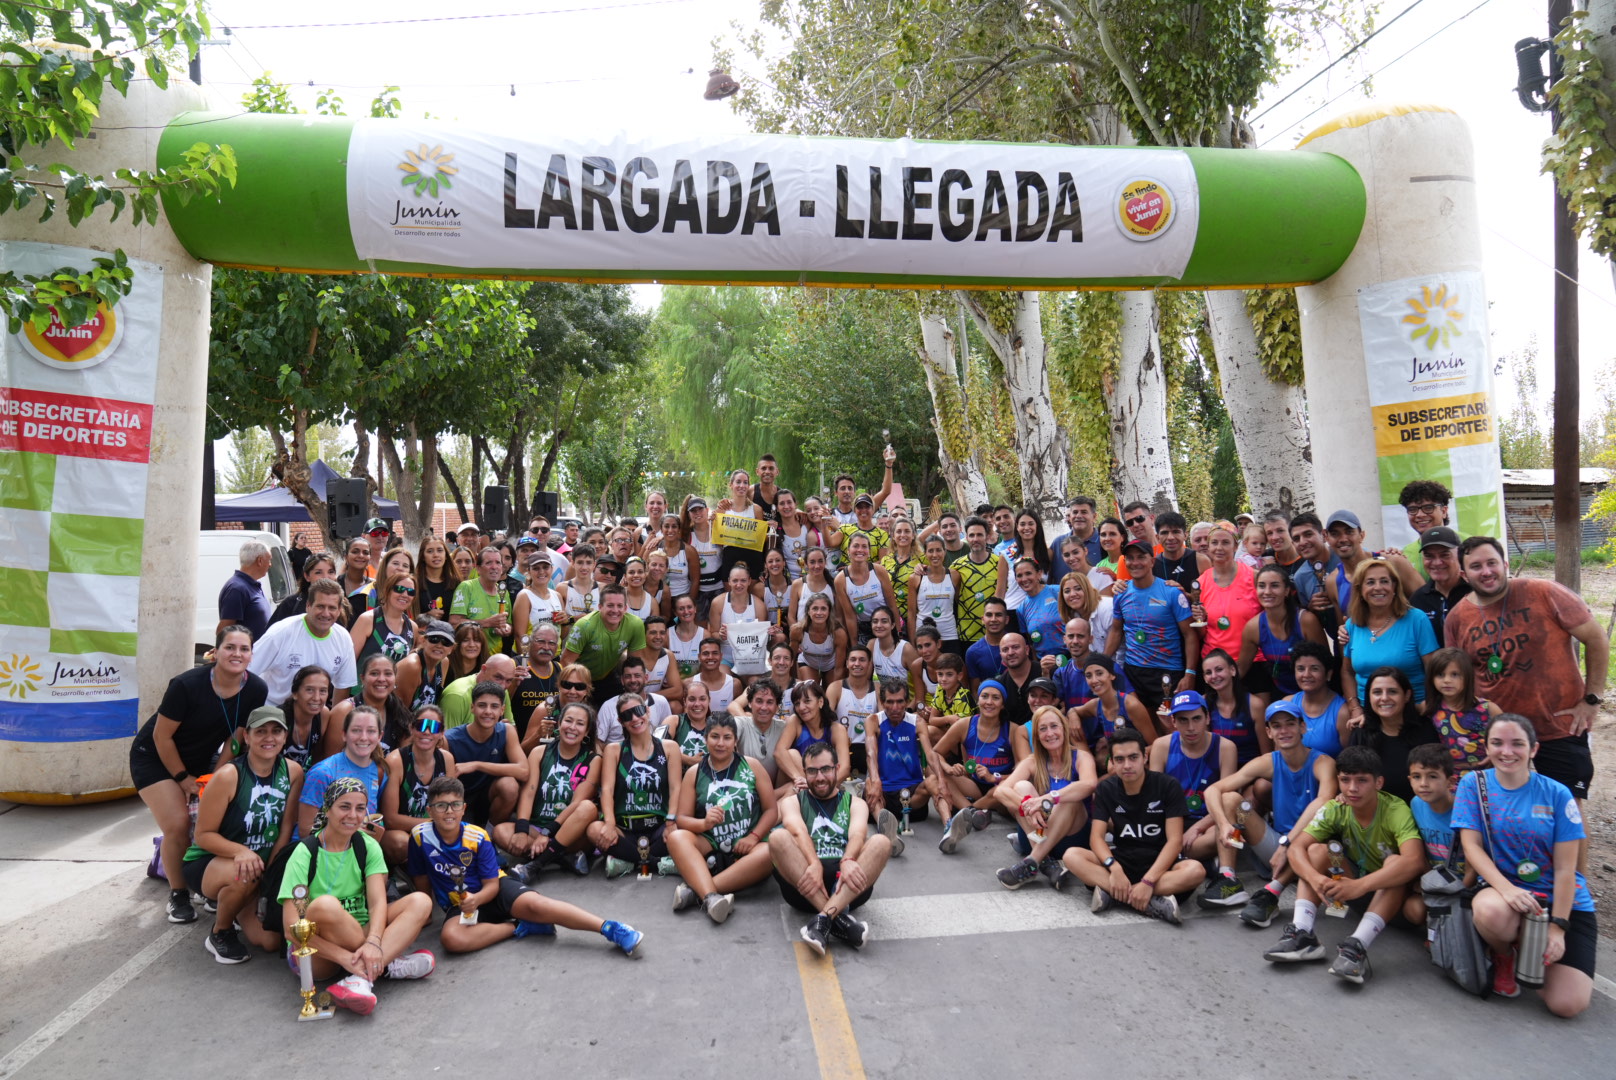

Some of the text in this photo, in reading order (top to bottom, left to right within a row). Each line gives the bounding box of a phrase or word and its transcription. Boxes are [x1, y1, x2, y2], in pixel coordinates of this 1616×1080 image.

[504, 152, 781, 236] LARGADA
[835, 165, 1083, 243] LLEGADA
[1122, 184, 1158, 201] Es lindo
[390, 199, 461, 226] Junín
[1127, 197, 1161, 215] vivir en
[414, 219, 461, 227] Municipalidad
[394, 229, 426, 237] Desarrollo
[46, 325, 93, 339] Junín
[1407, 352, 1465, 383] Junín
[2, 420, 127, 447] DE DEPORTES
[1401, 418, 1488, 443] DE DEPORTES
[721, 516, 759, 532] PROACTIVE
[1469, 607, 1531, 642] DON'T
[736, 635, 760, 644] ÁGATHA
[1477, 633, 1530, 662] STOP
[47, 660, 120, 686] Junín
[73, 676, 121, 685] Municipalidad
[1119, 824, 1161, 838] AIG
